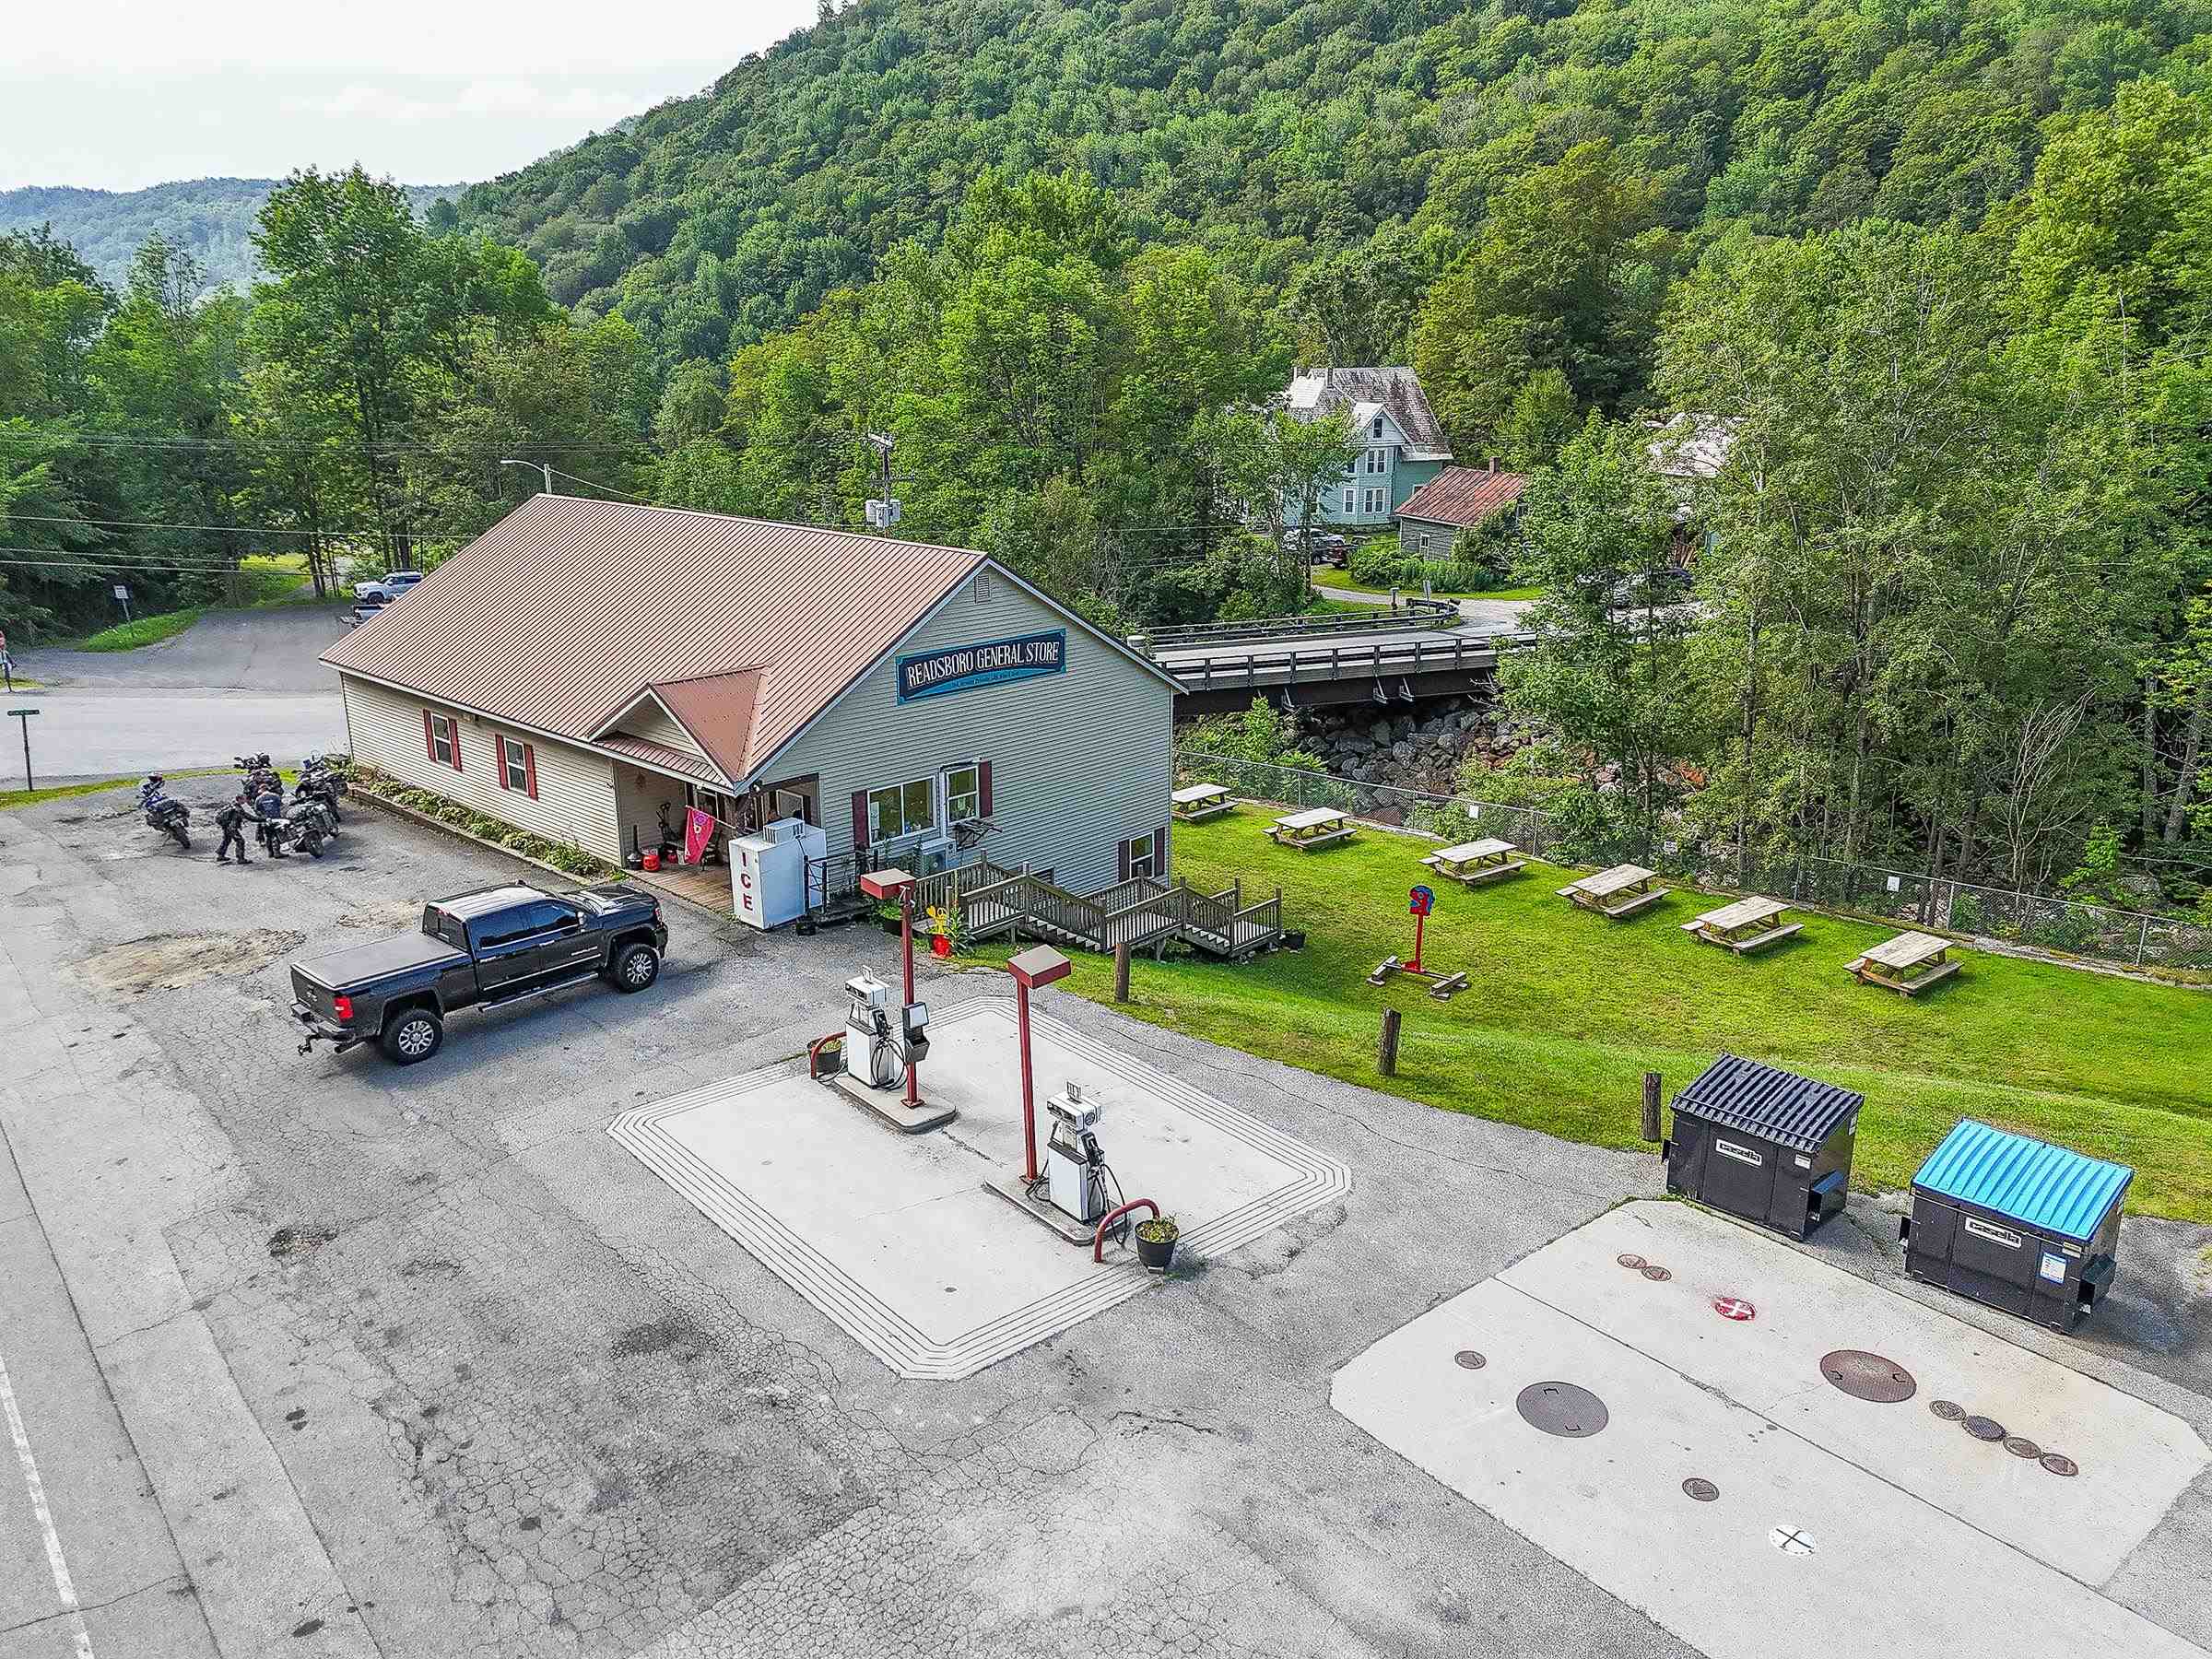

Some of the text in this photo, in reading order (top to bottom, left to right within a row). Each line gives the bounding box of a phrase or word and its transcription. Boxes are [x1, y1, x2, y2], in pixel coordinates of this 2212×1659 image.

[908, 652, 973, 687] READSBORO
[976, 644, 1024, 668] GENERAL
[1026, 642, 1059, 662] STORE
[740, 852, 753, 911] ICE
